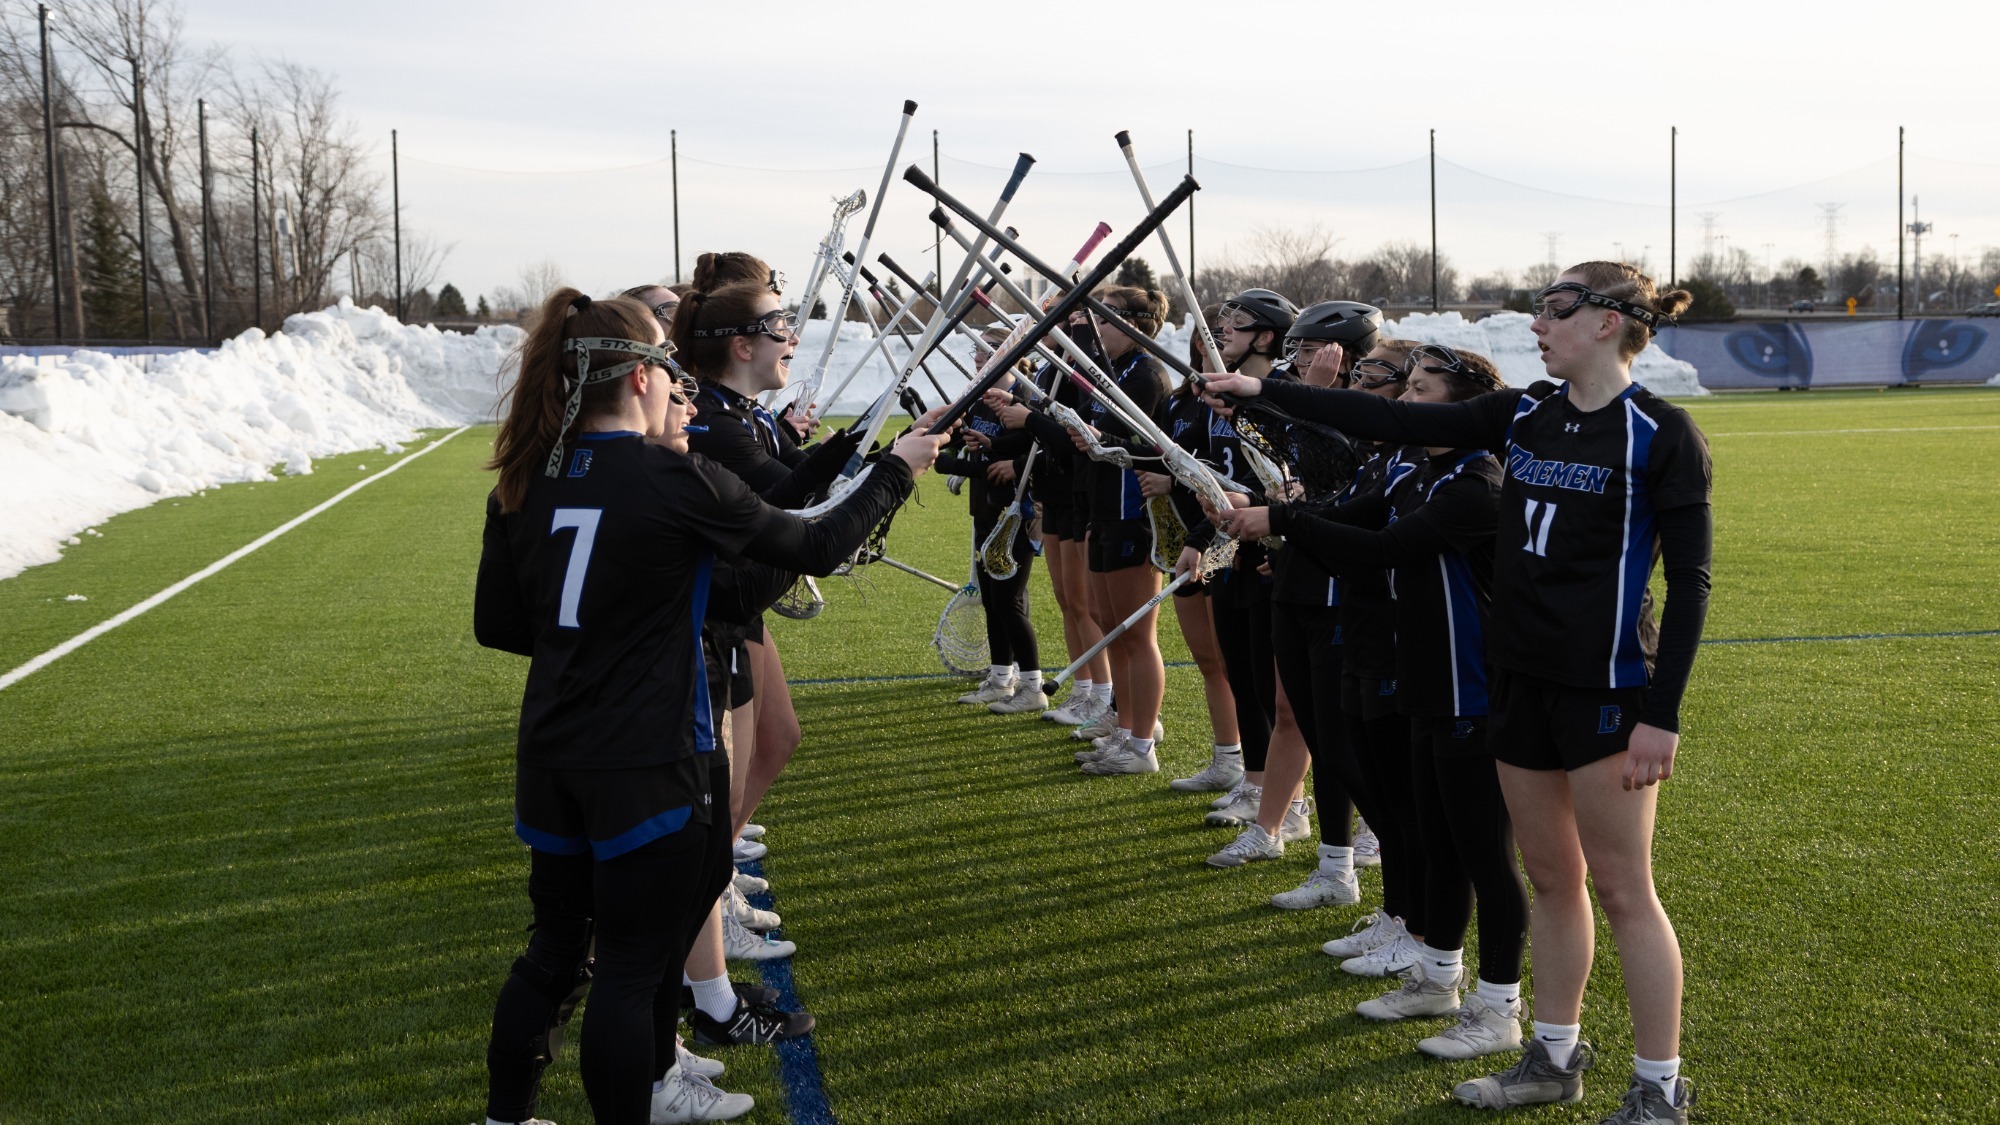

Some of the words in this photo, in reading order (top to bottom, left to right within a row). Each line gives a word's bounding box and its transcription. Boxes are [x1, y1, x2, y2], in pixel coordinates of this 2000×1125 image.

[841, 283, 852, 306] GAIT
[1589, 294, 1622, 310] STX
[714, 326, 739, 336] STX
[746, 324, 762, 334] ST
[600, 338, 632, 351] STX
[632, 344, 651, 353] PLUS
[894, 367, 913, 398] GAIT
[1087, 365, 1114, 390] GAIT
[562, 400, 579, 428] STX
[1222, 446, 1235, 481] 3
[1509, 443, 1613, 494] DAEMEN
[1522, 498, 1558, 557] 11
[549, 507, 605, 629] 7
[1147, 594, 1162, 607] GAIT
